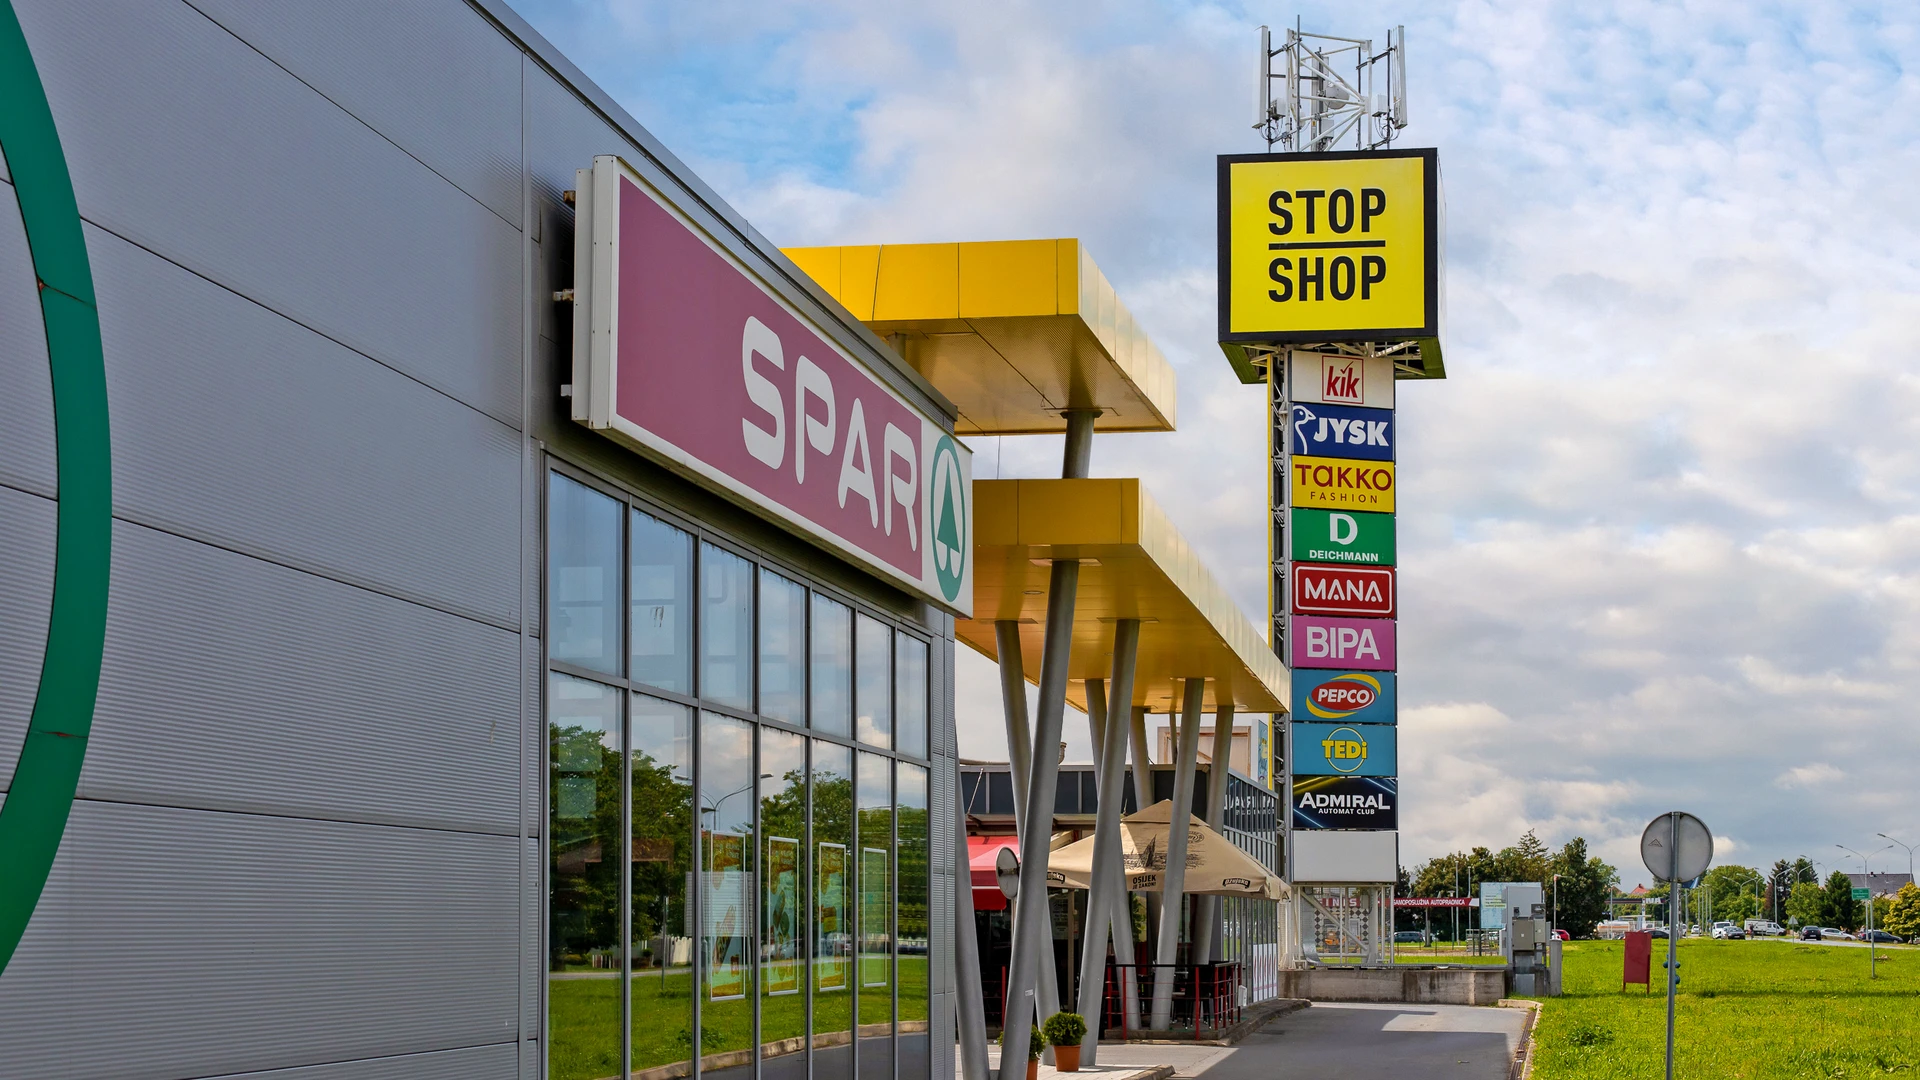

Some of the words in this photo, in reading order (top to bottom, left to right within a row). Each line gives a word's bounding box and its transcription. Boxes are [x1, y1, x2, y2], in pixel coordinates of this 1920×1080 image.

[1268, 188, 1386, 235] STOP
[1268, 256, 1386, 302] SHOP
[742, 316, 917, 551] SPAR
[1313, 417, 1389, 446] JYSK
[1310, 491, 1378, 504] FASHION
[1329, 513, 1358, 545] D
[1309, 549, 1379, 562] DEICHMANN
[1305, 577, 1383, 603] MANA
[1306, 626, 1381, 660] BIPA
[1318, 688, 1370, 704] PEPCO
[1321, 740, 1368, 759] TEDi
[1299, 792, 1391, 810] ADMIRAL
[1318, 807, 1354, 815] AUTOMAT
[1132, 874, 1157, 884] OSIJEK
